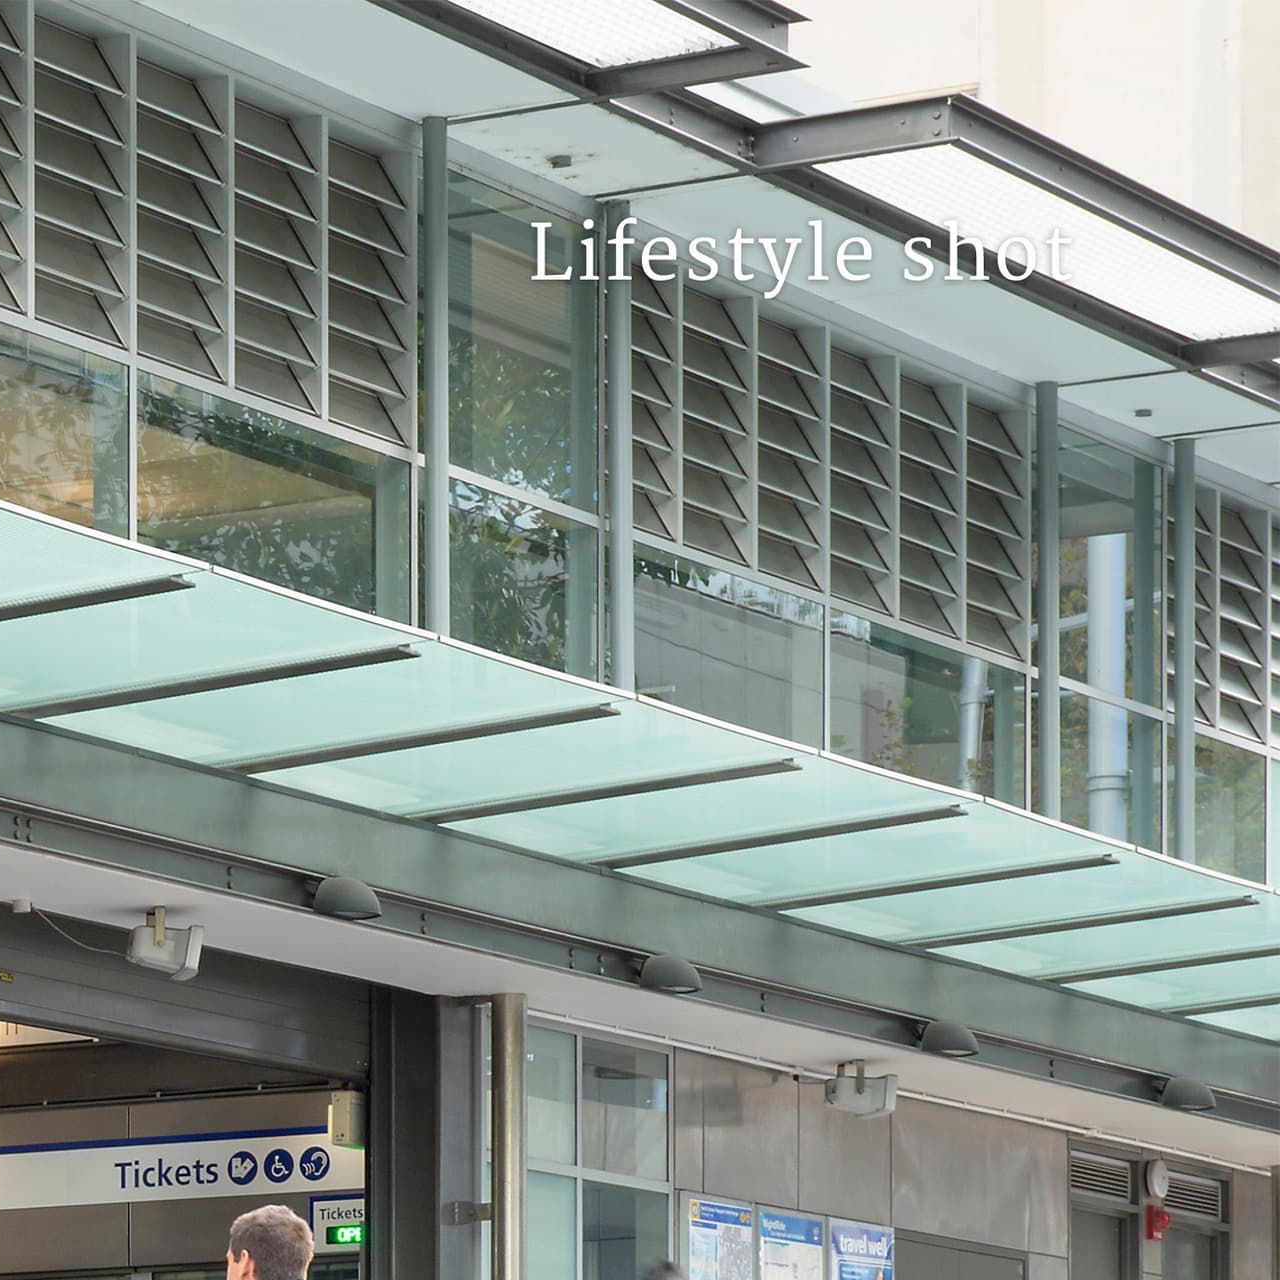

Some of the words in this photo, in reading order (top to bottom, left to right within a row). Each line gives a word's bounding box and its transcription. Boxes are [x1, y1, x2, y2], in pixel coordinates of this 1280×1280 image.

[114, 1158, 219, 1190] Tickets
[319, 1206, 364, 1221] Tickets
[336, 1227, 363, 1243] OPE
[840, 1233, 867, 1255] travel
[868, 1236, 887, 1257] well
